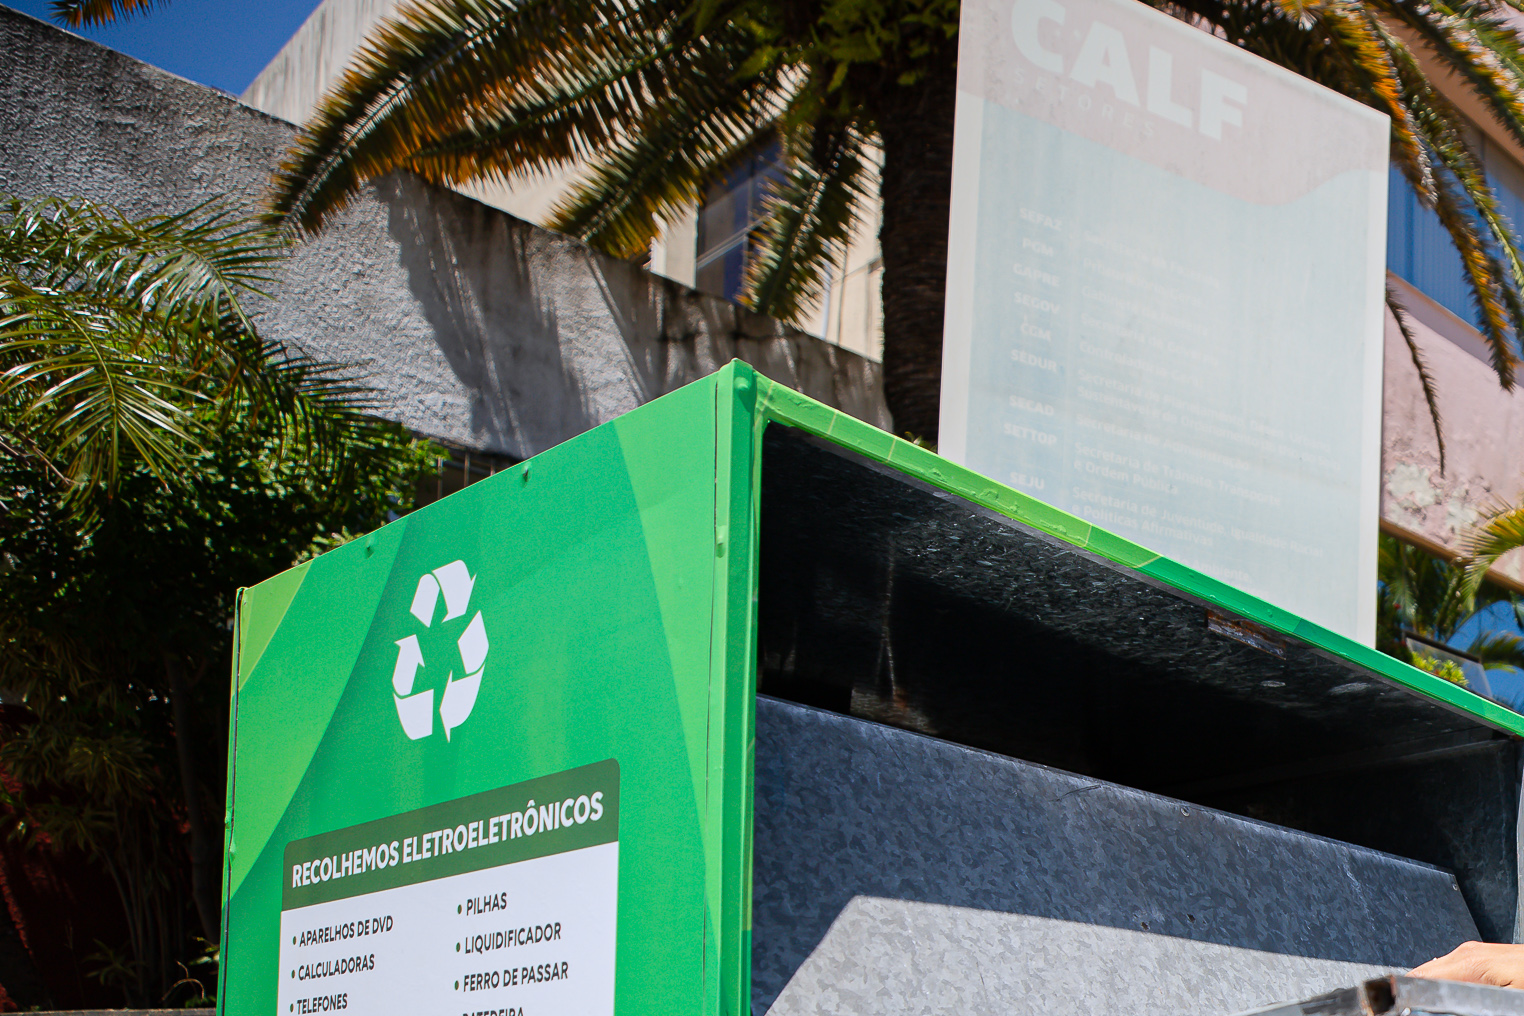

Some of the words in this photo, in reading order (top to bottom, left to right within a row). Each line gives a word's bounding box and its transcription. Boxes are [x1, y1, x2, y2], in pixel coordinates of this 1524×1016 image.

[1010, 0, 1246, 142] CALF
[1014, 67, 1157, 138] SETORES
[1019, 206, 1063, 232] SEFAZ
[1022, 237, 1054, 258] PGM
[1013, 262, 1060, 288] GAPRE
[1014, 291, 1061, 317] SEGOV
[1020, 321, 1052, 343] CGM
[1011, 348, 1057, 373] SEDUR
[1009, 394, 1055, 418] SECAD
[1003, 422, 1057, 448] SETTOP
[1074, 440, 1140, 470] Secretaria
[1010, 470, 1045, 491] SEJU
[1085, 461, 1129, 483] Ordem
[1072, 485, 1138, 514] Secretaria
[1141, 503, 1157, 519] de
[1141, 519, 1213, 548] Afirmativas
[291, 840, 400, 889] RECOLHEMOS
[402, 791, 604, 865] ELETROELETRÔNICOS
[466, 892, 507, 916] PILHAS
[299, 922, 355, 947] APARELHOS
[357, 920, 370, 936] DE
[372, 916, 394, 934] DVD
[465, 922, 562, 954] LIQUIDIFICADOR
[298, 954, 375, 981] CALCULADORAS
[463, 971, 500, 992] FERRO
[502, 968, 519, 987] DE
[521, 962, 569, 984] PASSAR
[296, 993, 348, 1014] TELEFONES
